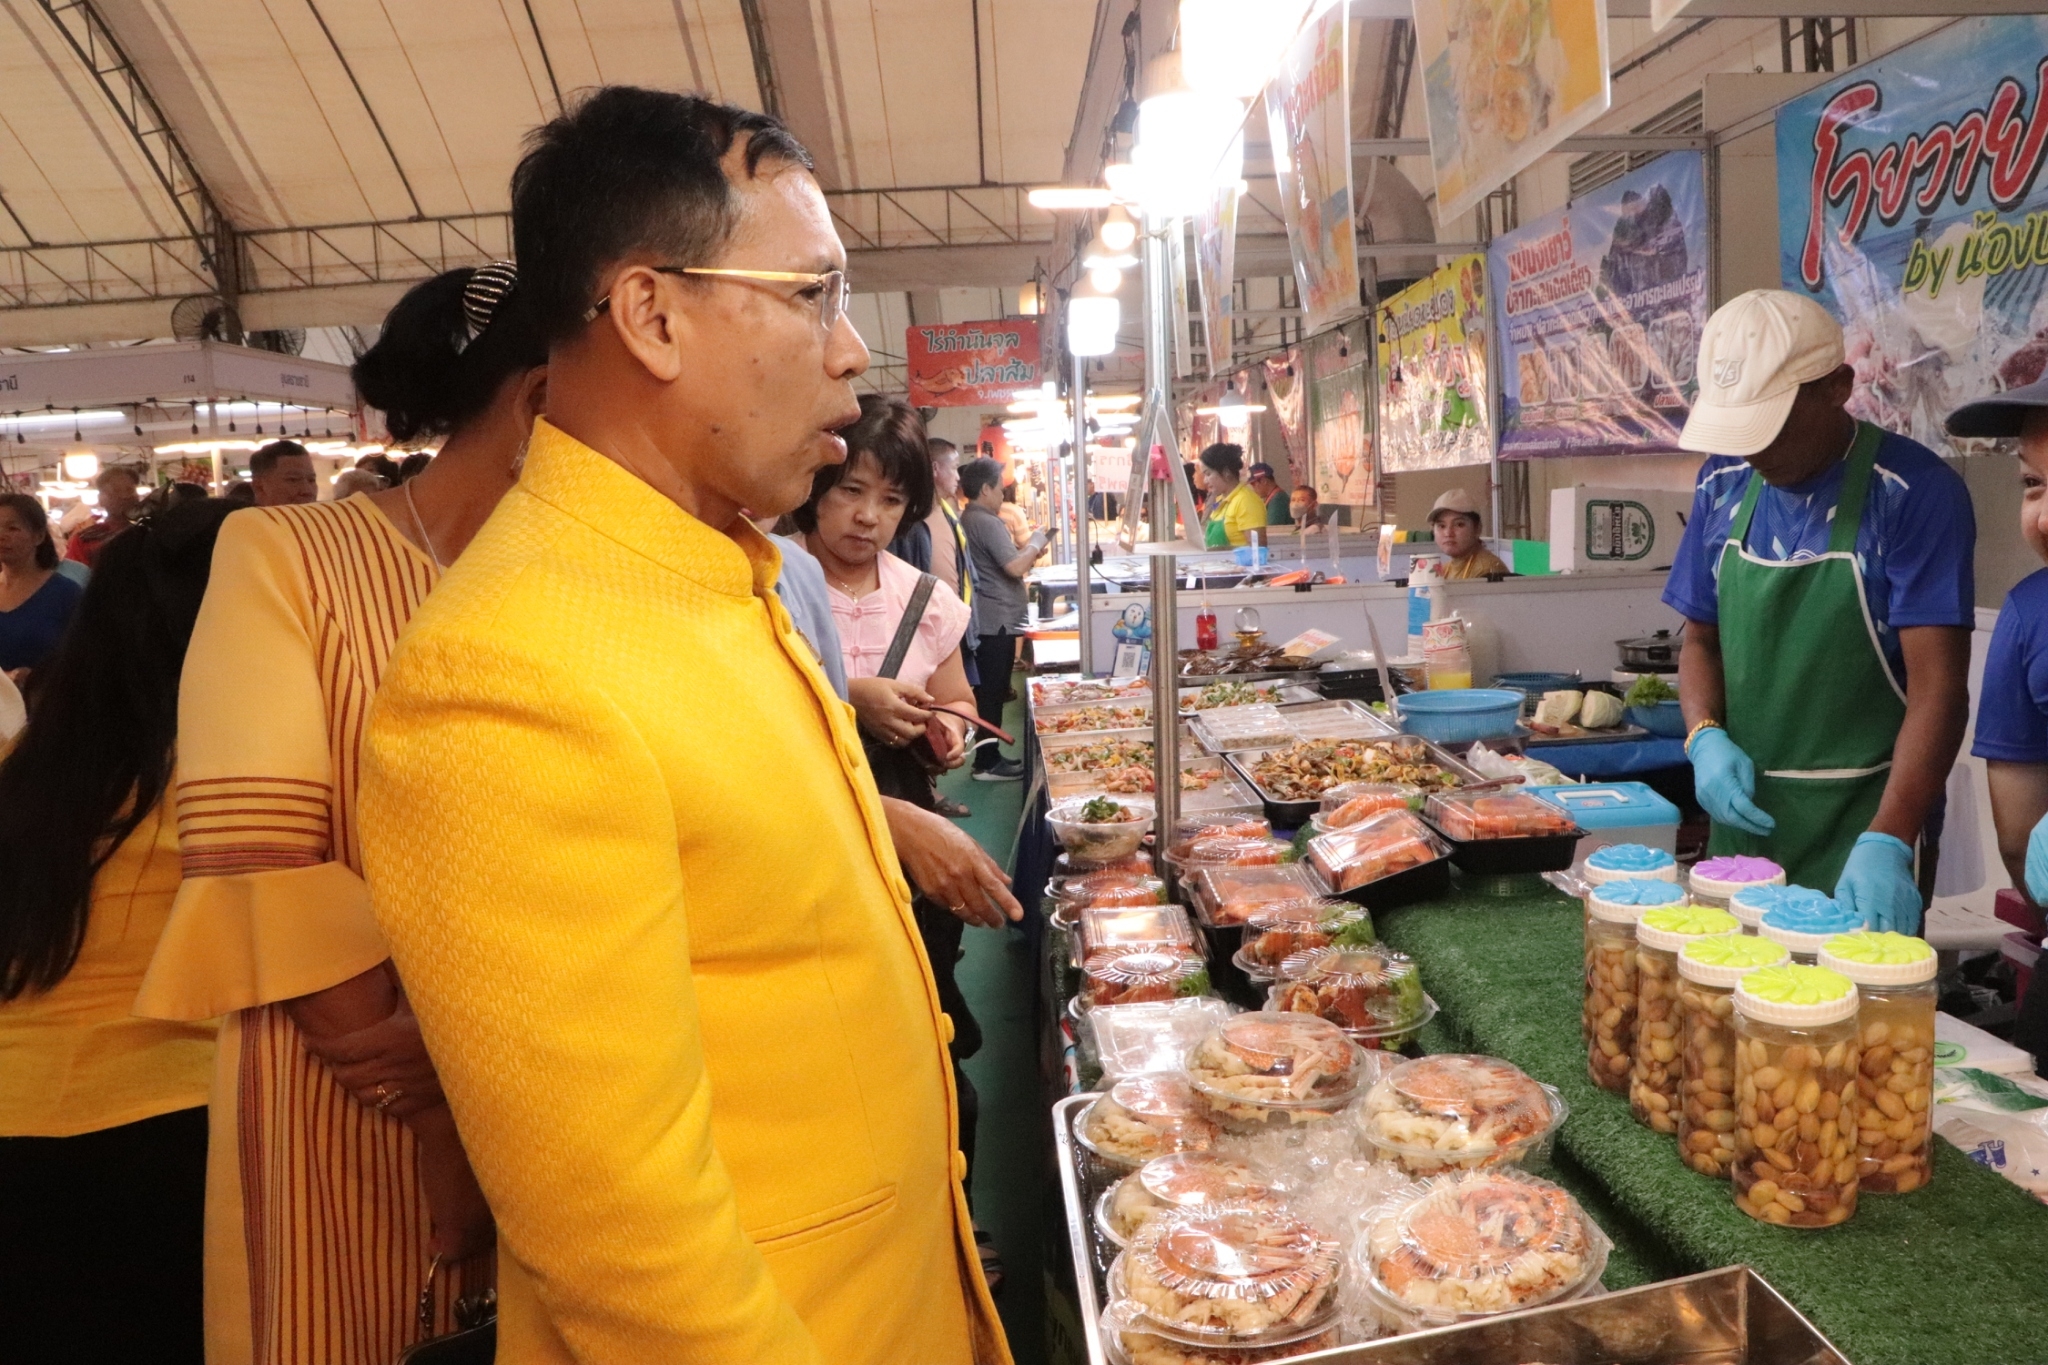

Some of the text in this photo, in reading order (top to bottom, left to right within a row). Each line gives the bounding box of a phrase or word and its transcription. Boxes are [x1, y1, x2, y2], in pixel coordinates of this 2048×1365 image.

[1801, 57, 2048, 290] โวยวาย
[1903, 239, 1953, 298] by
[922, 329, 1019, 356] ไร่กำนันจุล
[965, 358, 1034, 385] ปลาส้ม
